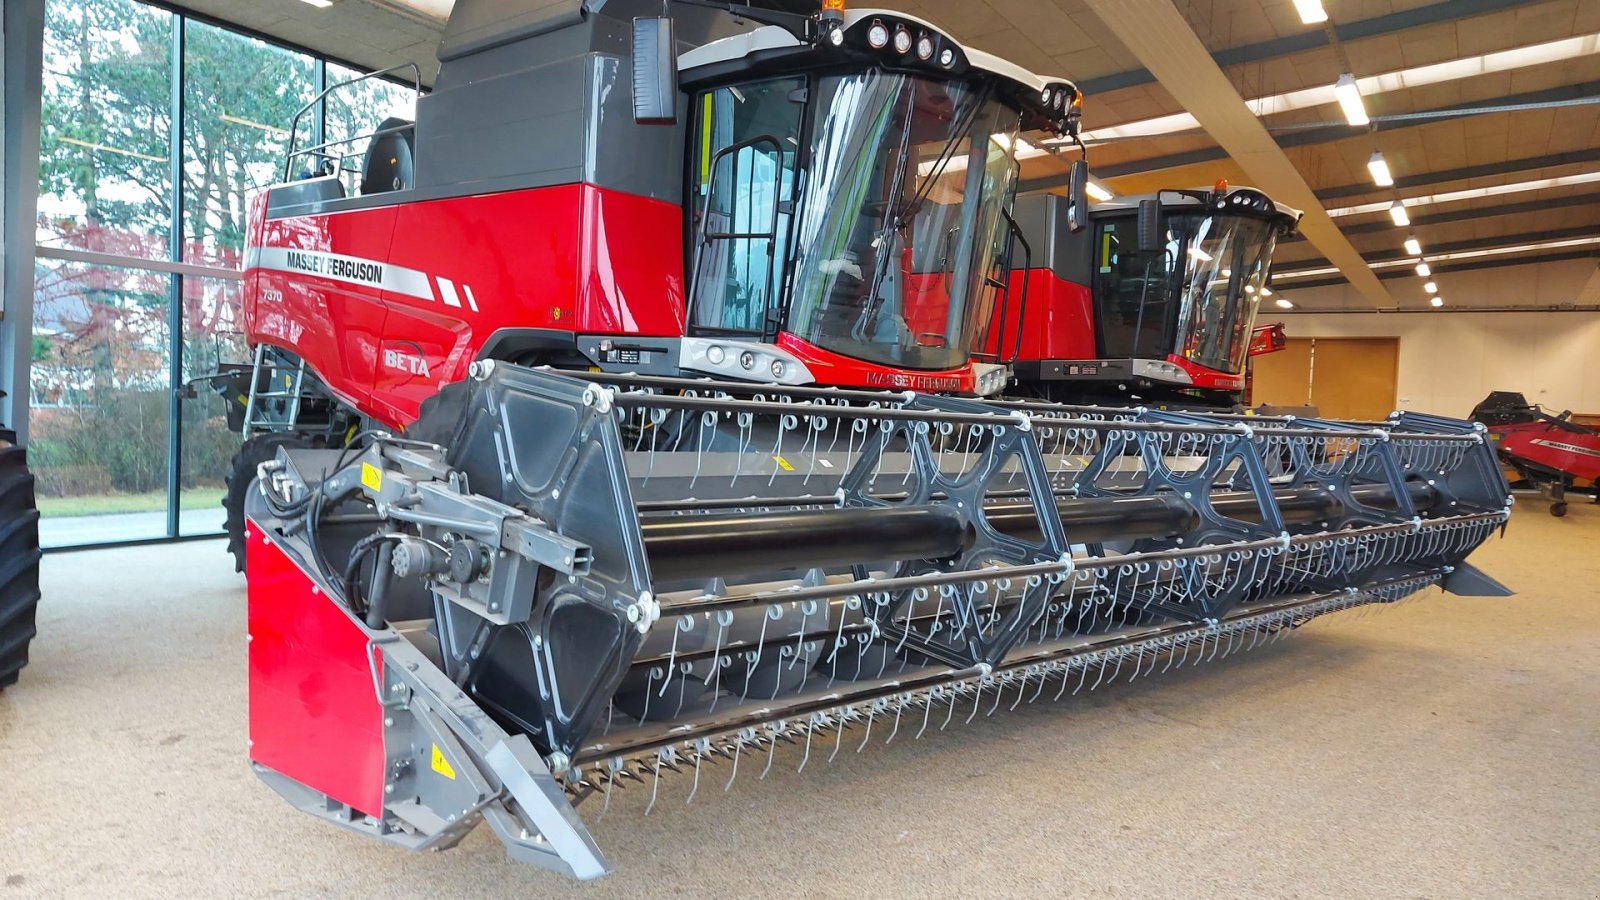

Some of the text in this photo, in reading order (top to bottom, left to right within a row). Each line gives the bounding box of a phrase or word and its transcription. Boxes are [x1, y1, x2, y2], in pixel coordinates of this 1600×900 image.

[287, 251, 382, 283] MASSEY FERGUSON
[263, 288, 282, 302] 7370
[384, 349, 430, 378] BETA
